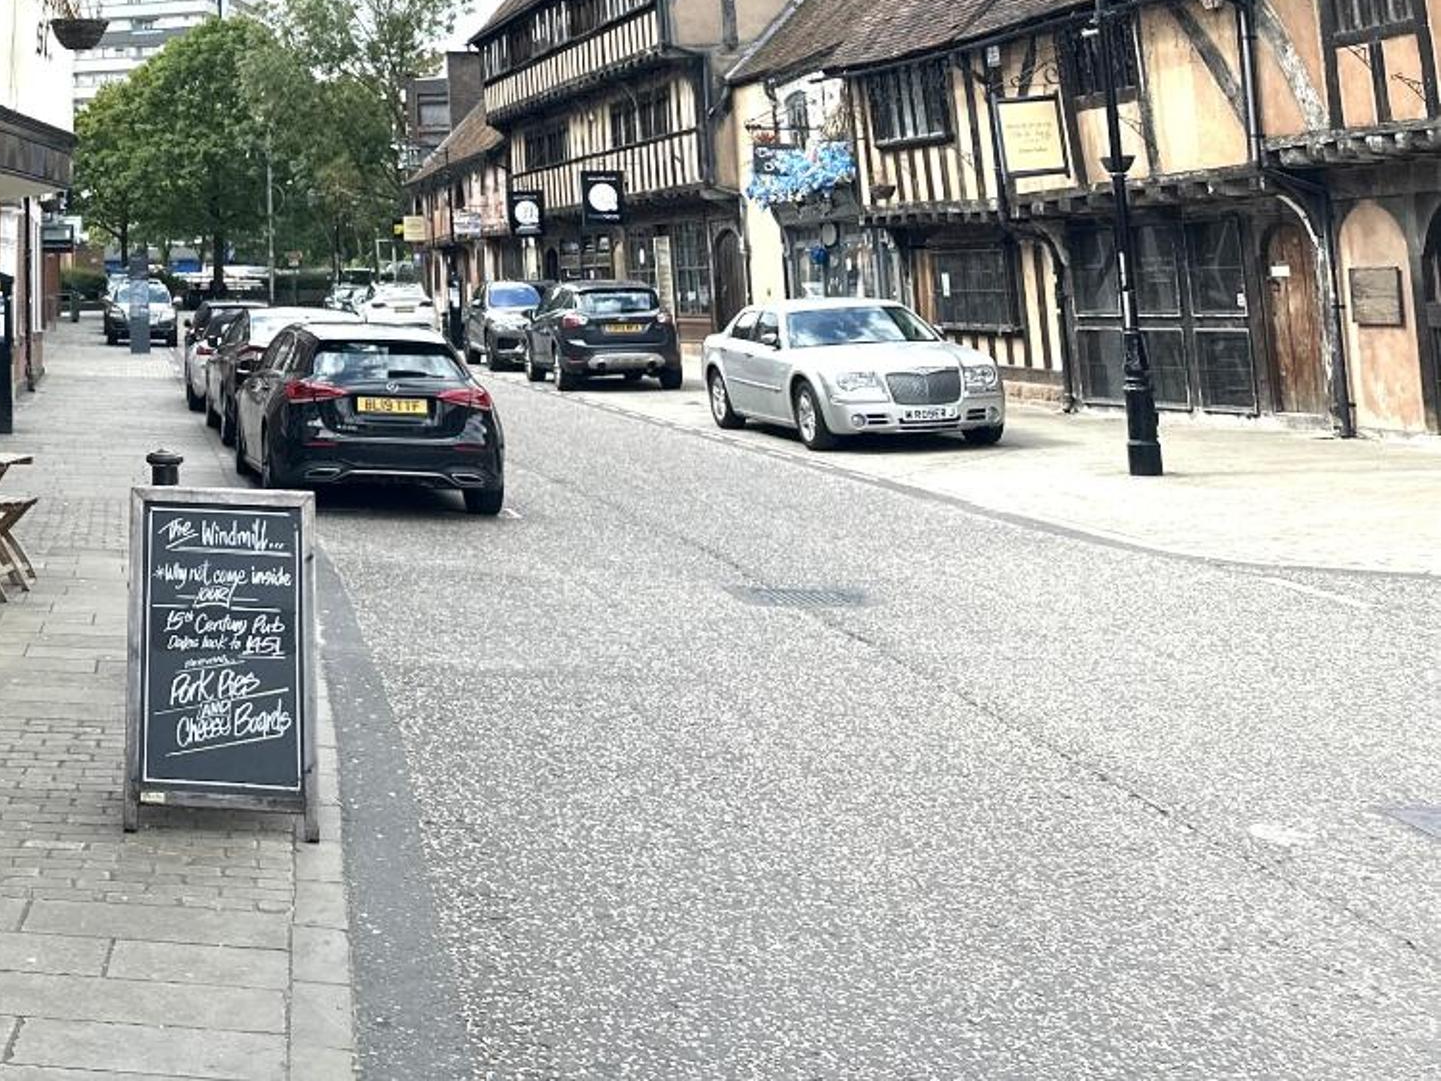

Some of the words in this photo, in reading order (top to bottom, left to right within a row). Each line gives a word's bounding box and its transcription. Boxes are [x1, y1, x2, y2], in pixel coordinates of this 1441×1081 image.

[158, 518, 197, 541] The
[251, 565, 292, 586] inside
[251, 614, 285, 634] Pub
[169, 669, 215, 705] Pork
[233, 698, 292, 737] Boards
